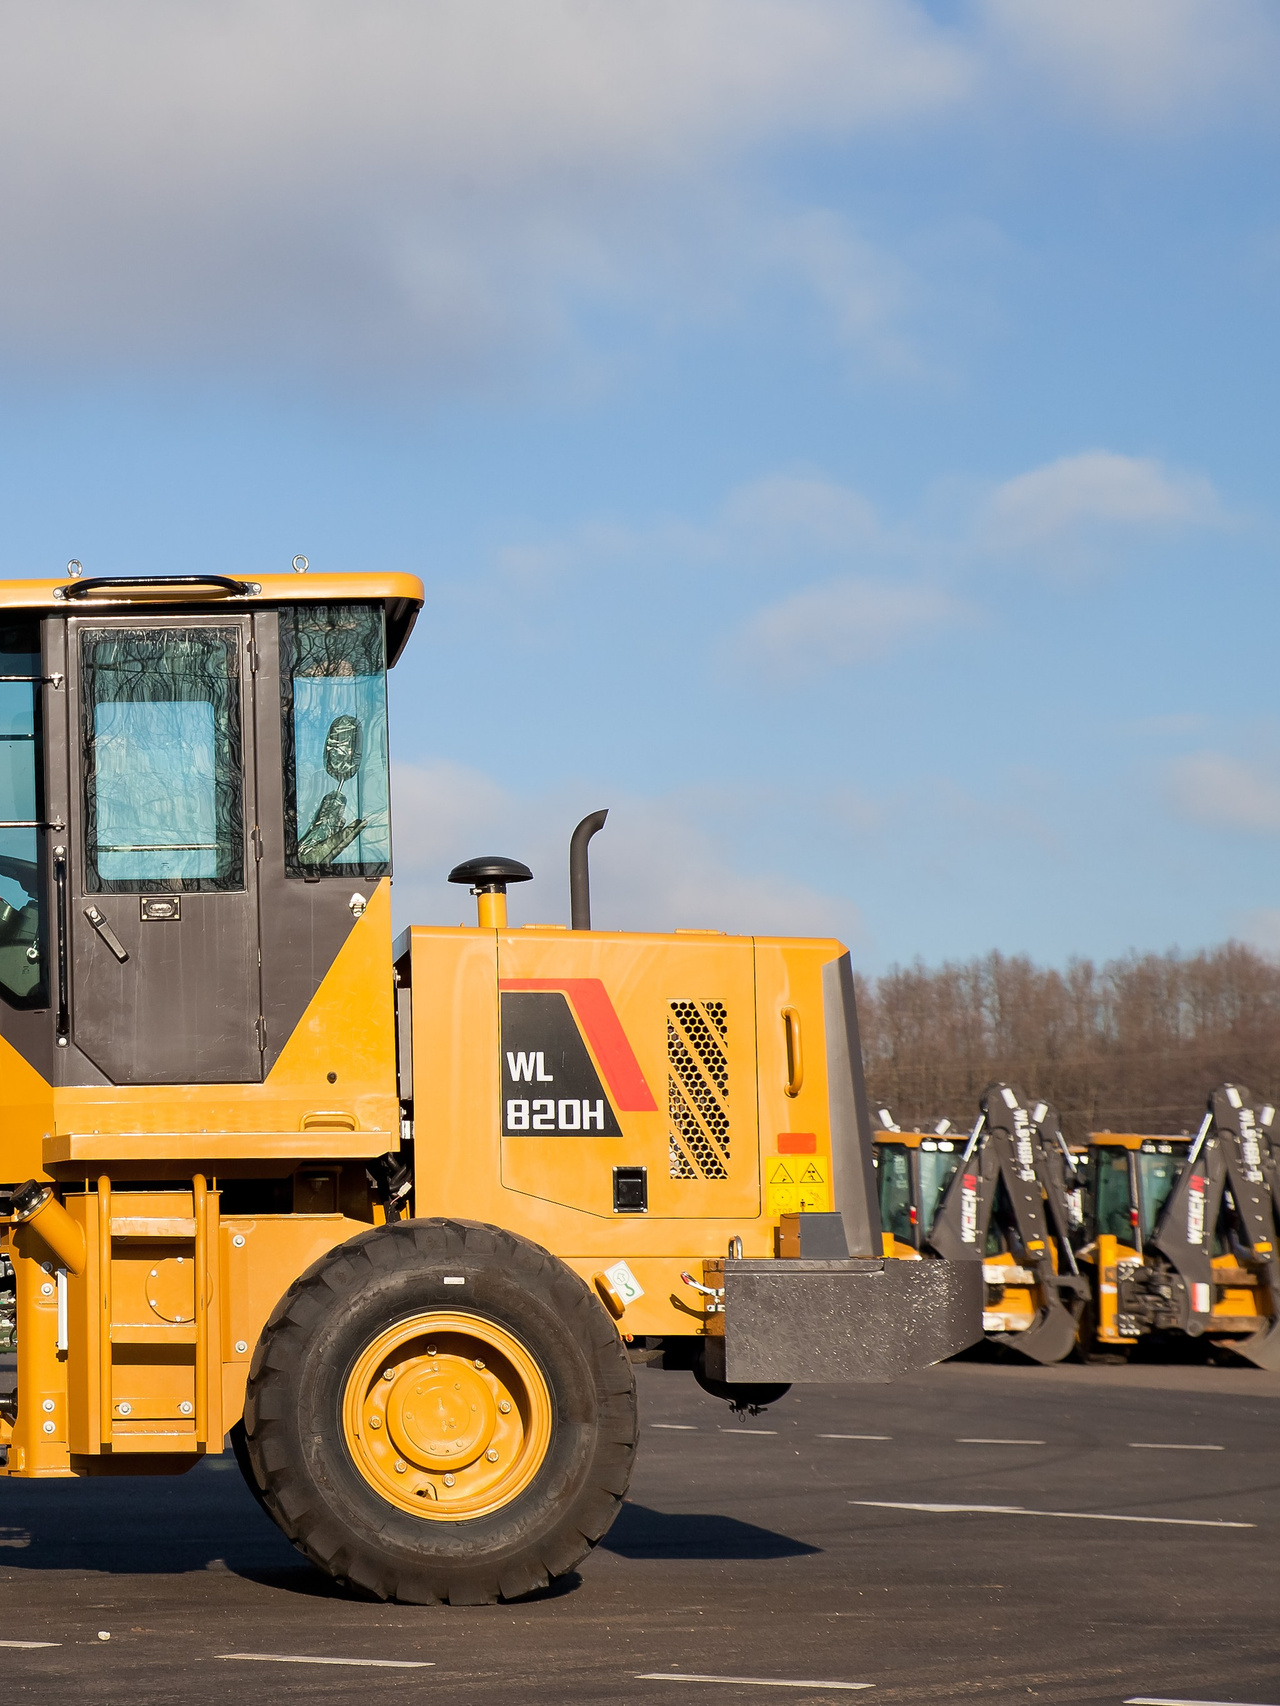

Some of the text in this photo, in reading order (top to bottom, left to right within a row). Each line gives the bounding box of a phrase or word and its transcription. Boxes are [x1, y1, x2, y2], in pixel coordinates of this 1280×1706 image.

[506, 1052, 554, 1082] WL
[506, 1099, 605, 1130] 820H
[961, 1174, 977, 1243] WEICHAI
